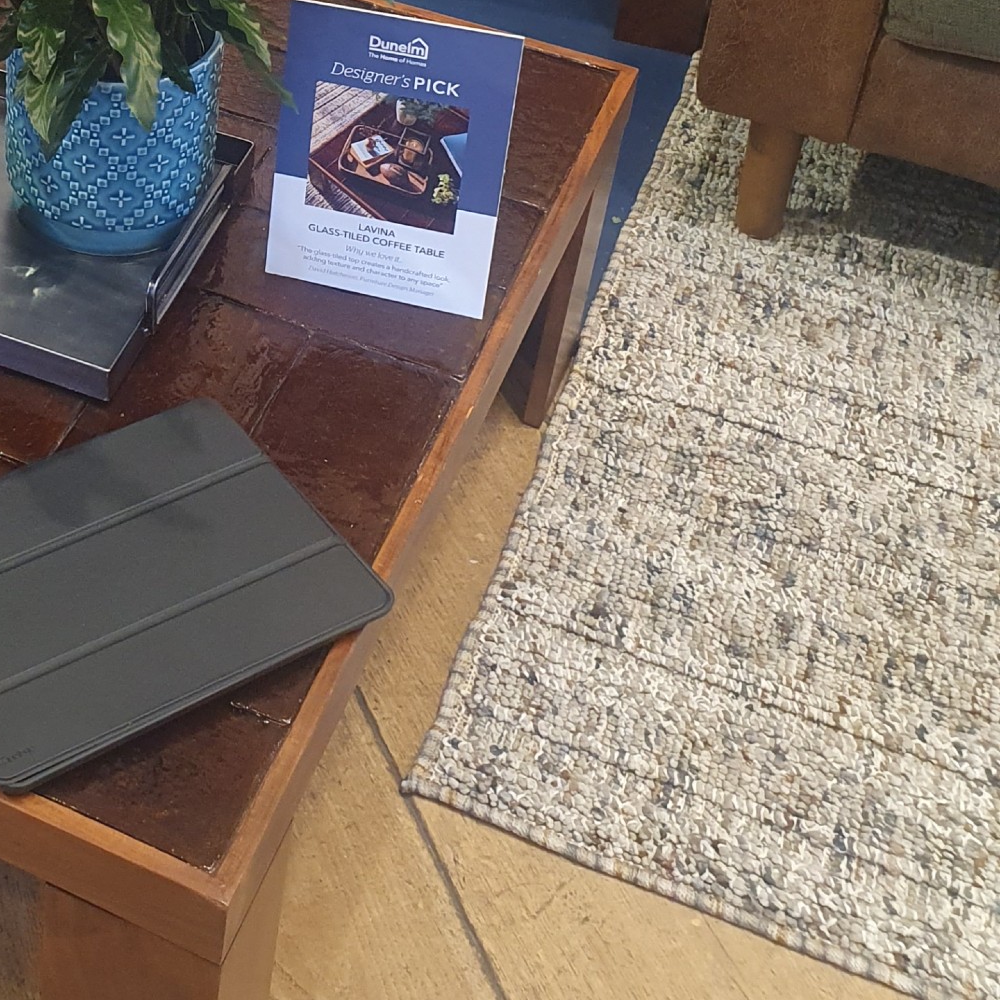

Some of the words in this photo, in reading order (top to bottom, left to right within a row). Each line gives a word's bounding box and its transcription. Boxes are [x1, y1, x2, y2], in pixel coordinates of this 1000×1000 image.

[369, 35, 427, 58] Dunelm
[368, 51, 379, 59] The
[379, 54, 398, 62] Home
[406, 58, 427, 67] Homes
[331, 61, 411, 89] Designer's
[413, 76, 461, 97] PICK
[358, 224, 396, 237] LAVINA
[308, 223, 371, 242] GLASS-TILED
[372, 237, 412, 251] COFFEE
[414, 246, 445, 258] TABLE
[345, 245, 364, 255] Why
